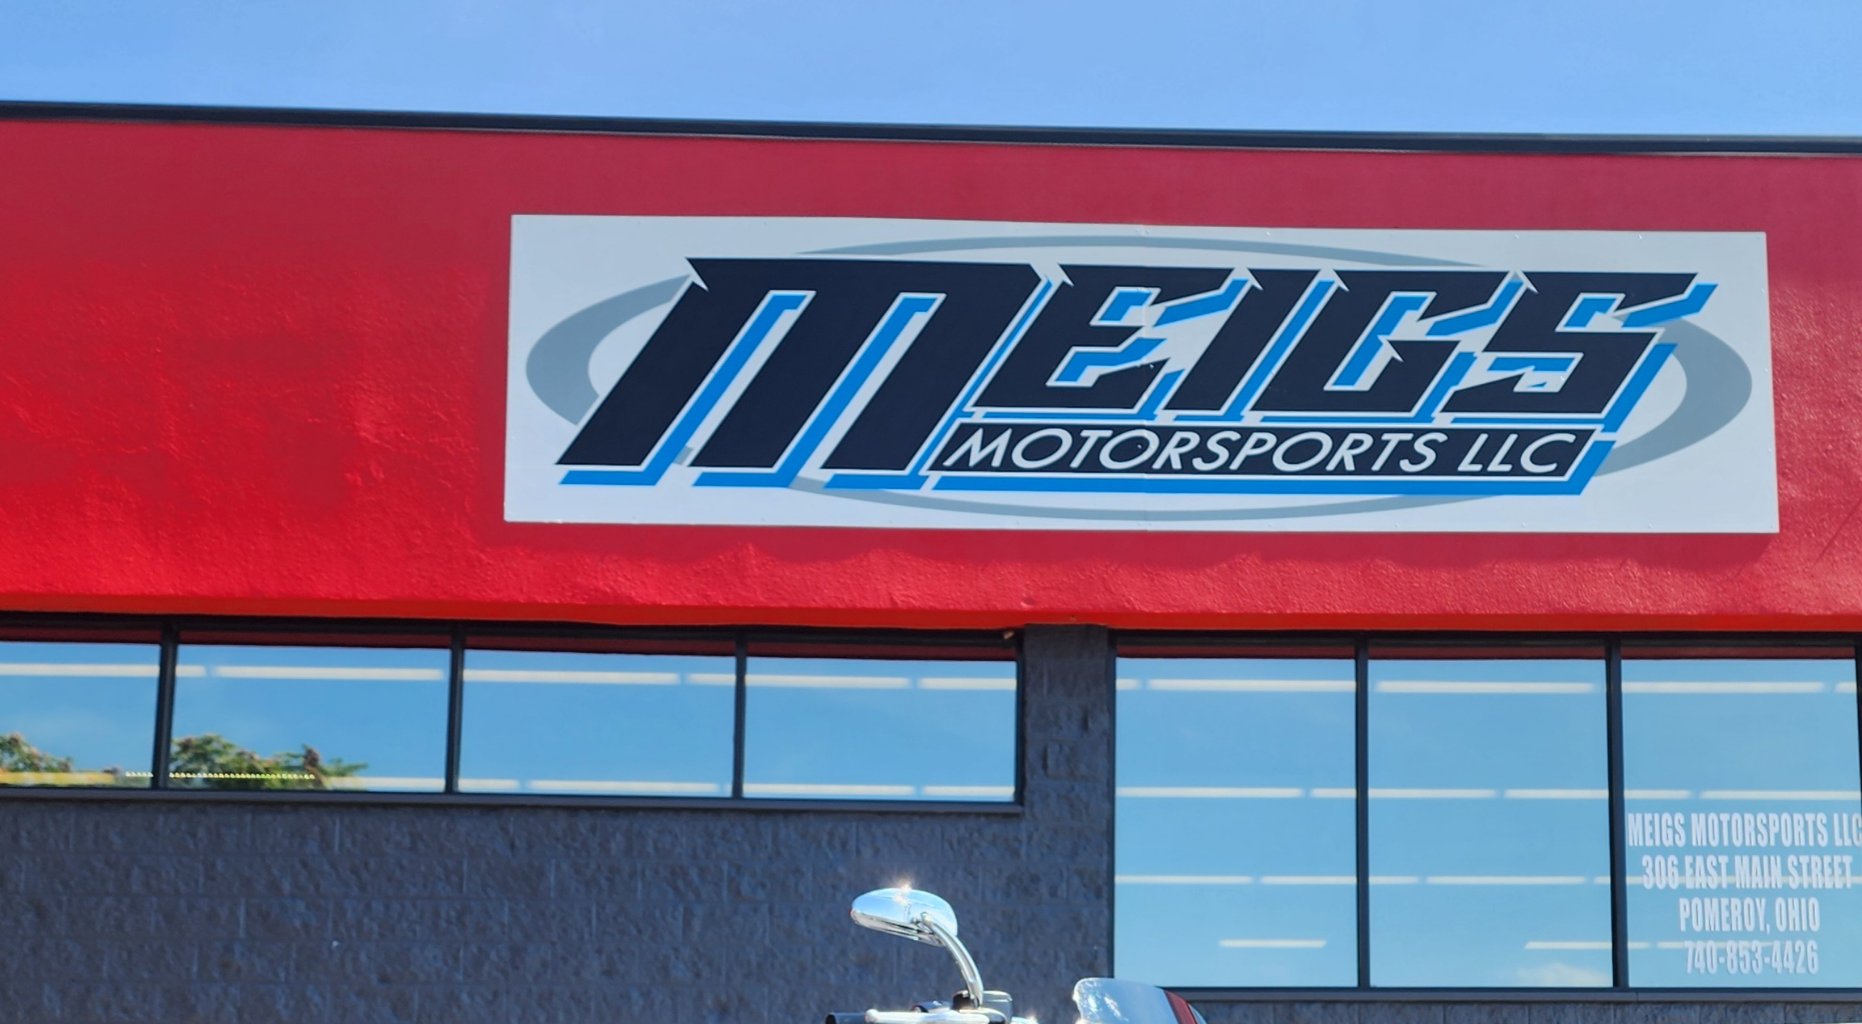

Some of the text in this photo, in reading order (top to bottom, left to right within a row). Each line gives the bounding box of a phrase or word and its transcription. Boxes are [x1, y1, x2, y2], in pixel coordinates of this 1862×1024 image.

[555, 257, 1716, 478] MEIGS
[942, 427, 1577, 474] MOTORSPORTS LLC
[1628, 812, 1862, 848] MEIGS MOTORSPORTS LLC
[1642, 854, 1854, 890] 306 EAST MAIN STREET
[1679, 897, 1821, 935] POMEROY, OHIO
[1684, 940, 1820, 975] 740-853-4426
